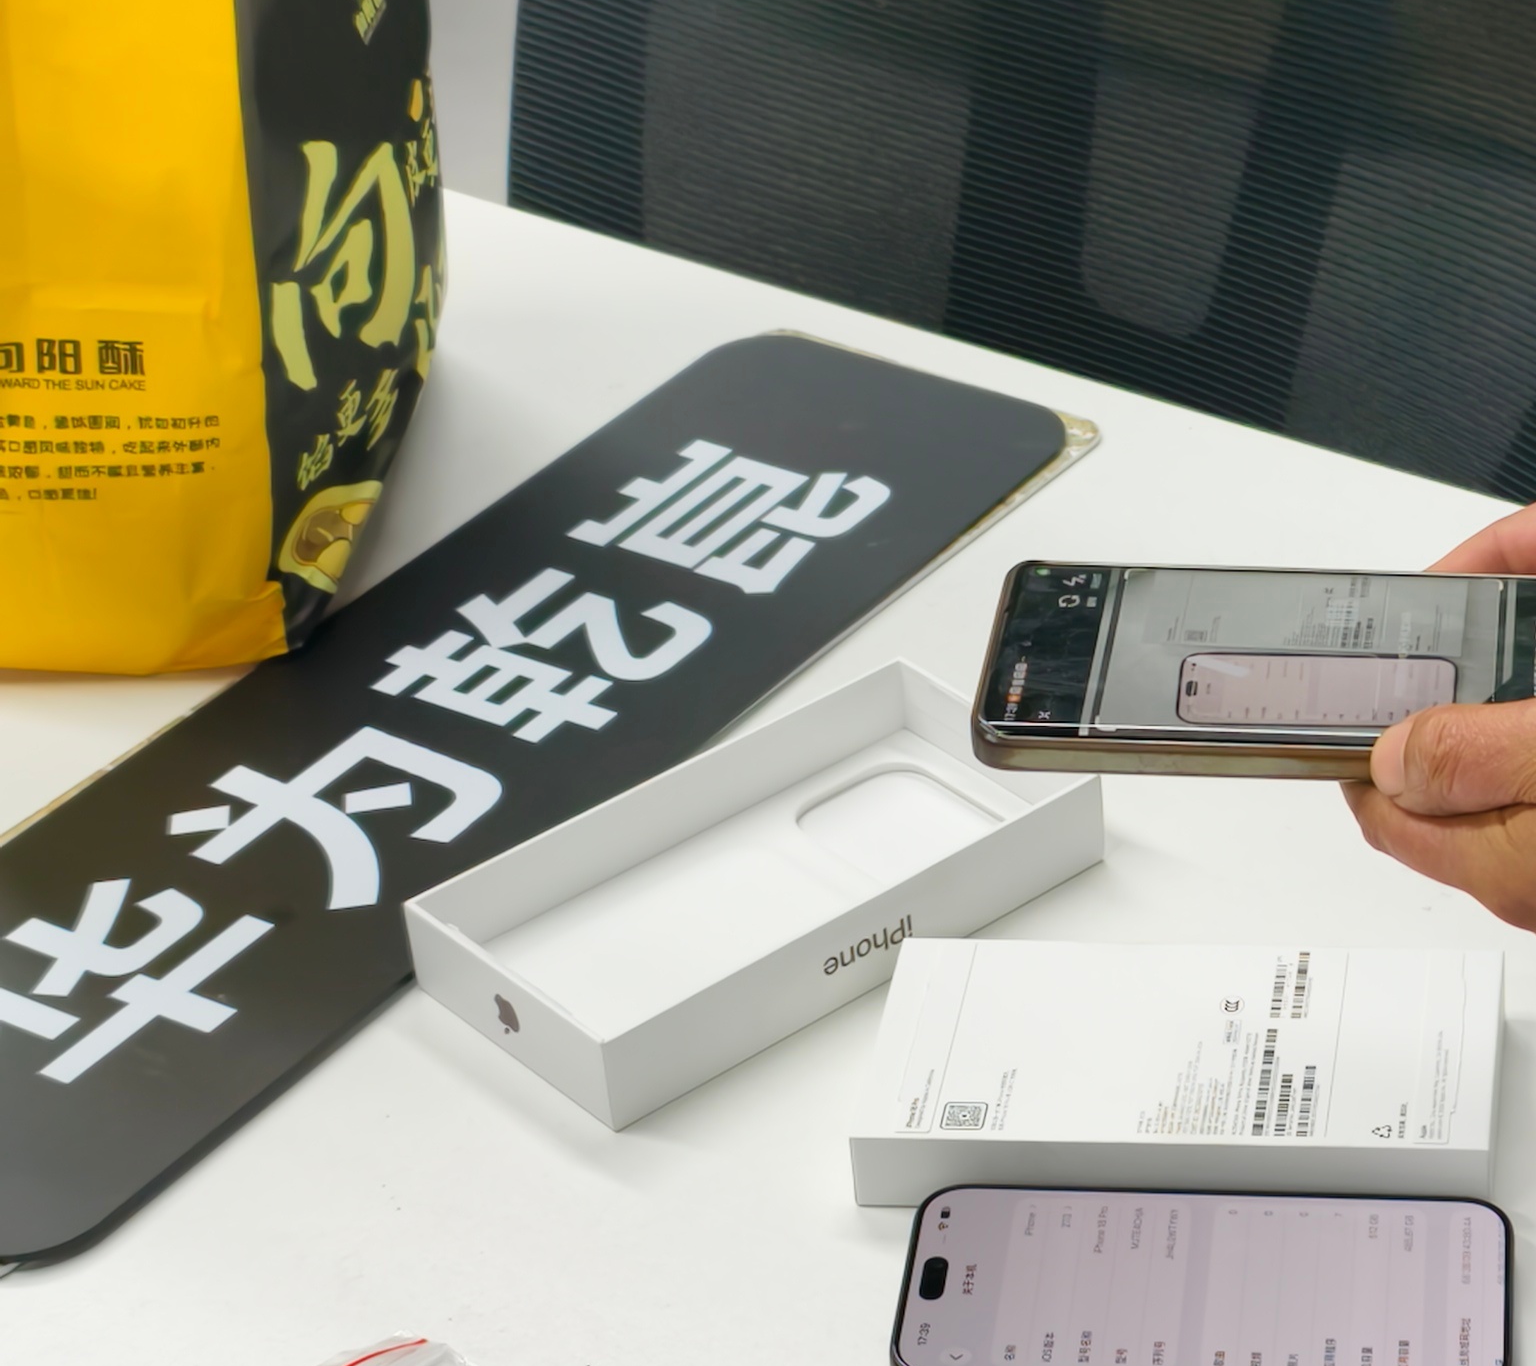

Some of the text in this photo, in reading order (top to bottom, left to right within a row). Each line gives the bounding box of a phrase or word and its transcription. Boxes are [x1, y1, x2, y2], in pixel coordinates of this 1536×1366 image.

[270, 139, 446, 392] 向
[43, 379, 71, 390] THE
[75, 379, 105, 391] SUN
[109, 380, 146, 392] CAKE
[822, 912, 914, 978] iPhone
[961, 1263, 978, 1296] 关于本机
[916, 1322, 931, 1347] 17:39
[1077, 1330, 1092, 1363] 型号名称
[1003, 1344, 1017, 1362] 名称
[1114, 1347, 1128, 1365] 型号
[1152, 1340, 1166, 1366] 序列号
